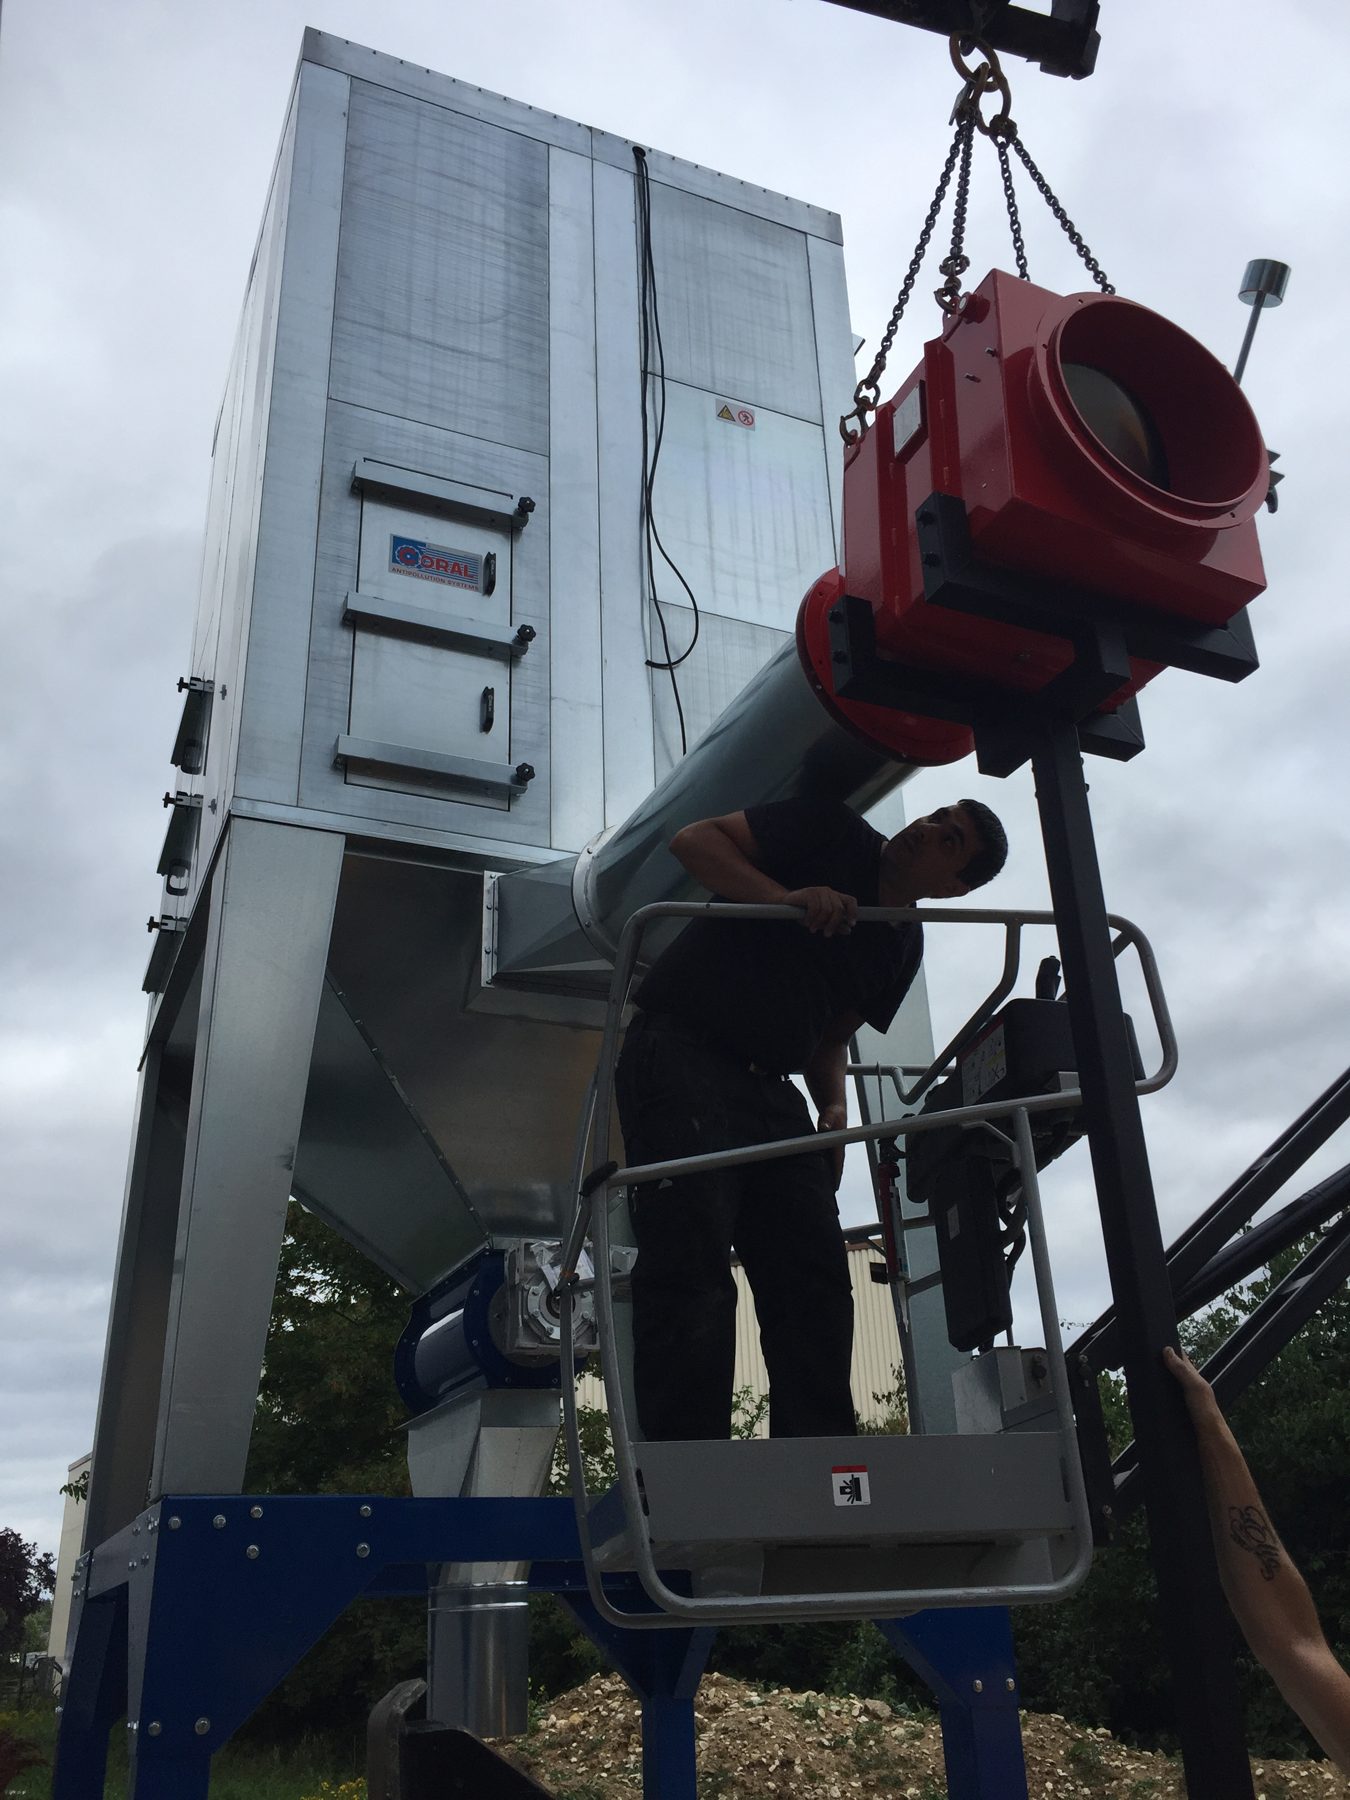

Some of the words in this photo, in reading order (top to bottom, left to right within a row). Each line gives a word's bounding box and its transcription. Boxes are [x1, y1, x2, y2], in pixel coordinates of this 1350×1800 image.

[398, 547, 476, 579] CORAL
[392, 567, 446, 584] ANTIPOLLUTION
[447, 580, 479, 591] SYSTEMS
